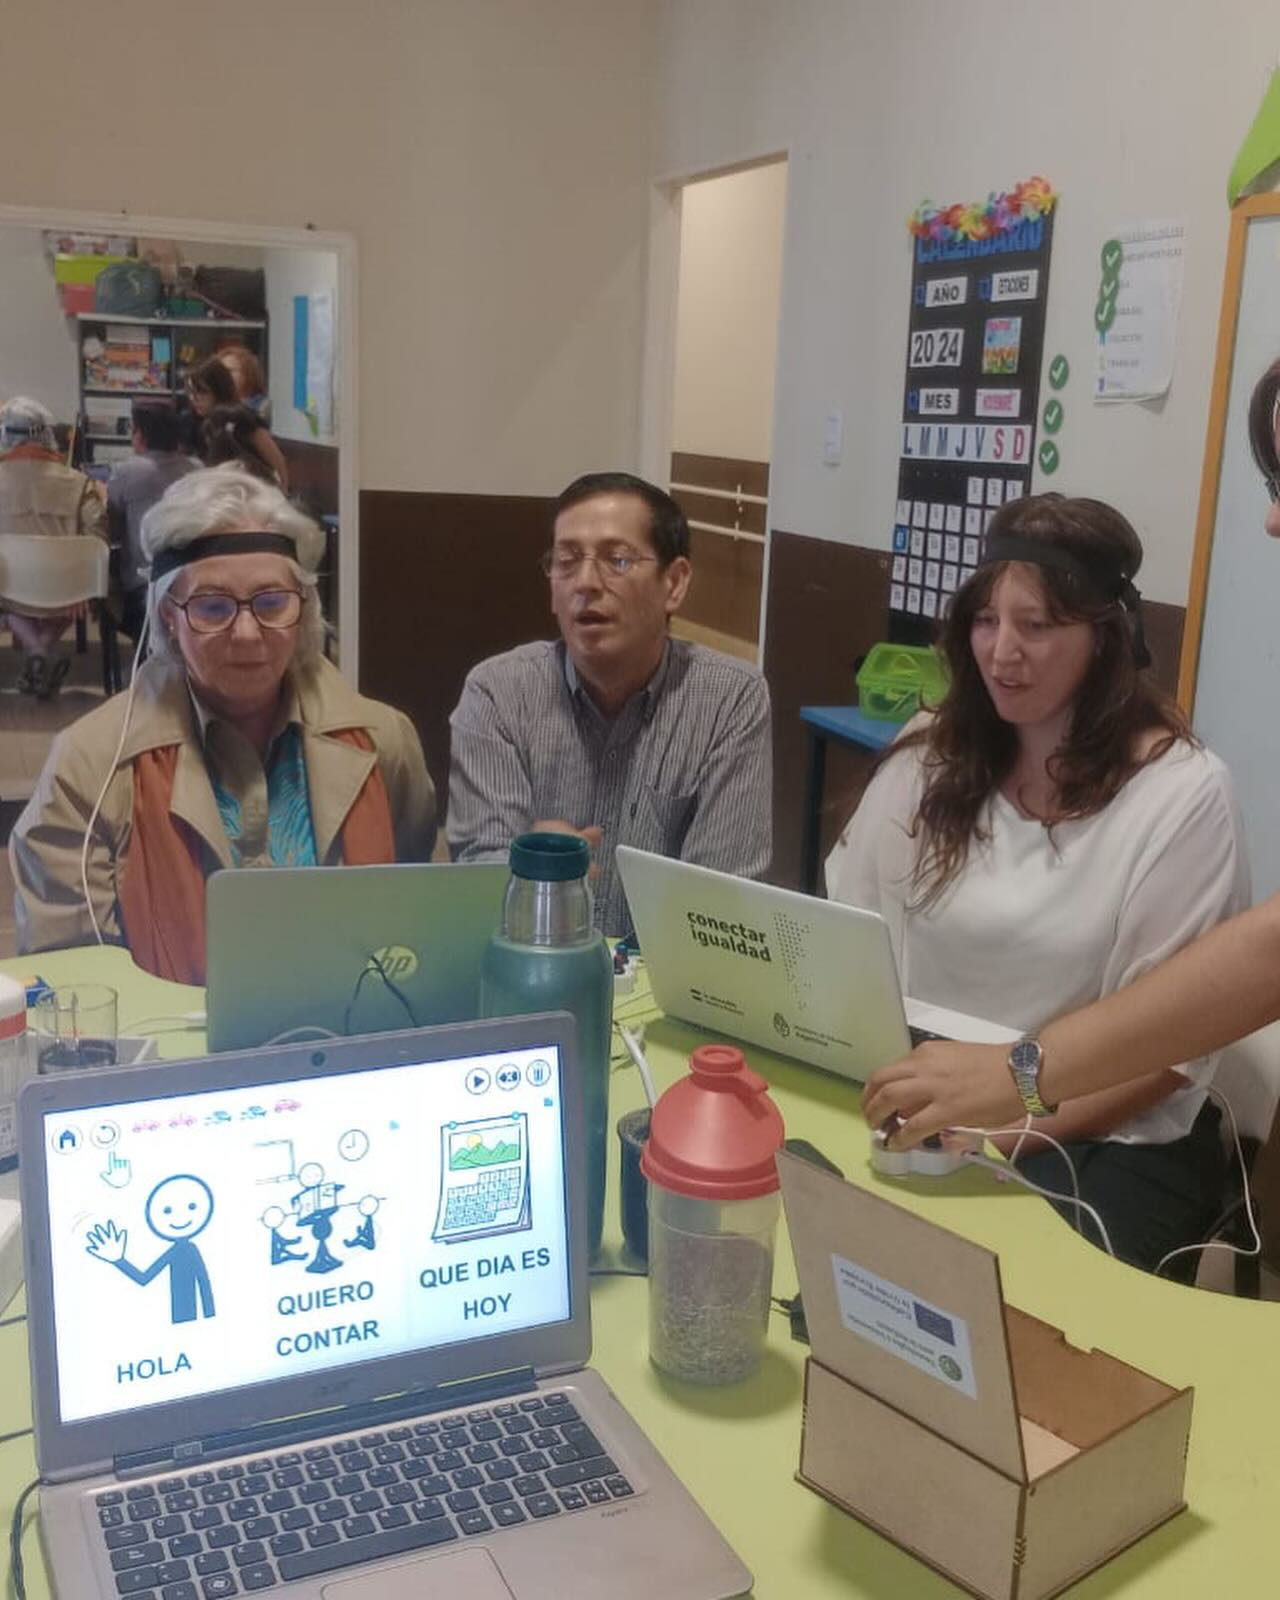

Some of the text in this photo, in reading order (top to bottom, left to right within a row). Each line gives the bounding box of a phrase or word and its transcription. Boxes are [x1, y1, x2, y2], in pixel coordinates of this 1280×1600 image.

[932, 283, 960, 302] AÑO
[924, 394, 952, 410] MES
[903, 426, 1025, 461] L M M J V S D
[687, 911, 767, 943] conectar
[690, 925, 772, 962] igualdad
[381, 946, 412, 978] hp
[419, 1247, 551, 1290] QUE DIA ES
[277, 1280, 375, 1316] QUIERO
[463, 1293, 513, 1321] HOY
[276, 1319, 380, 1358] CONTAR
[116, 1351, 192, 1385] HOLA
